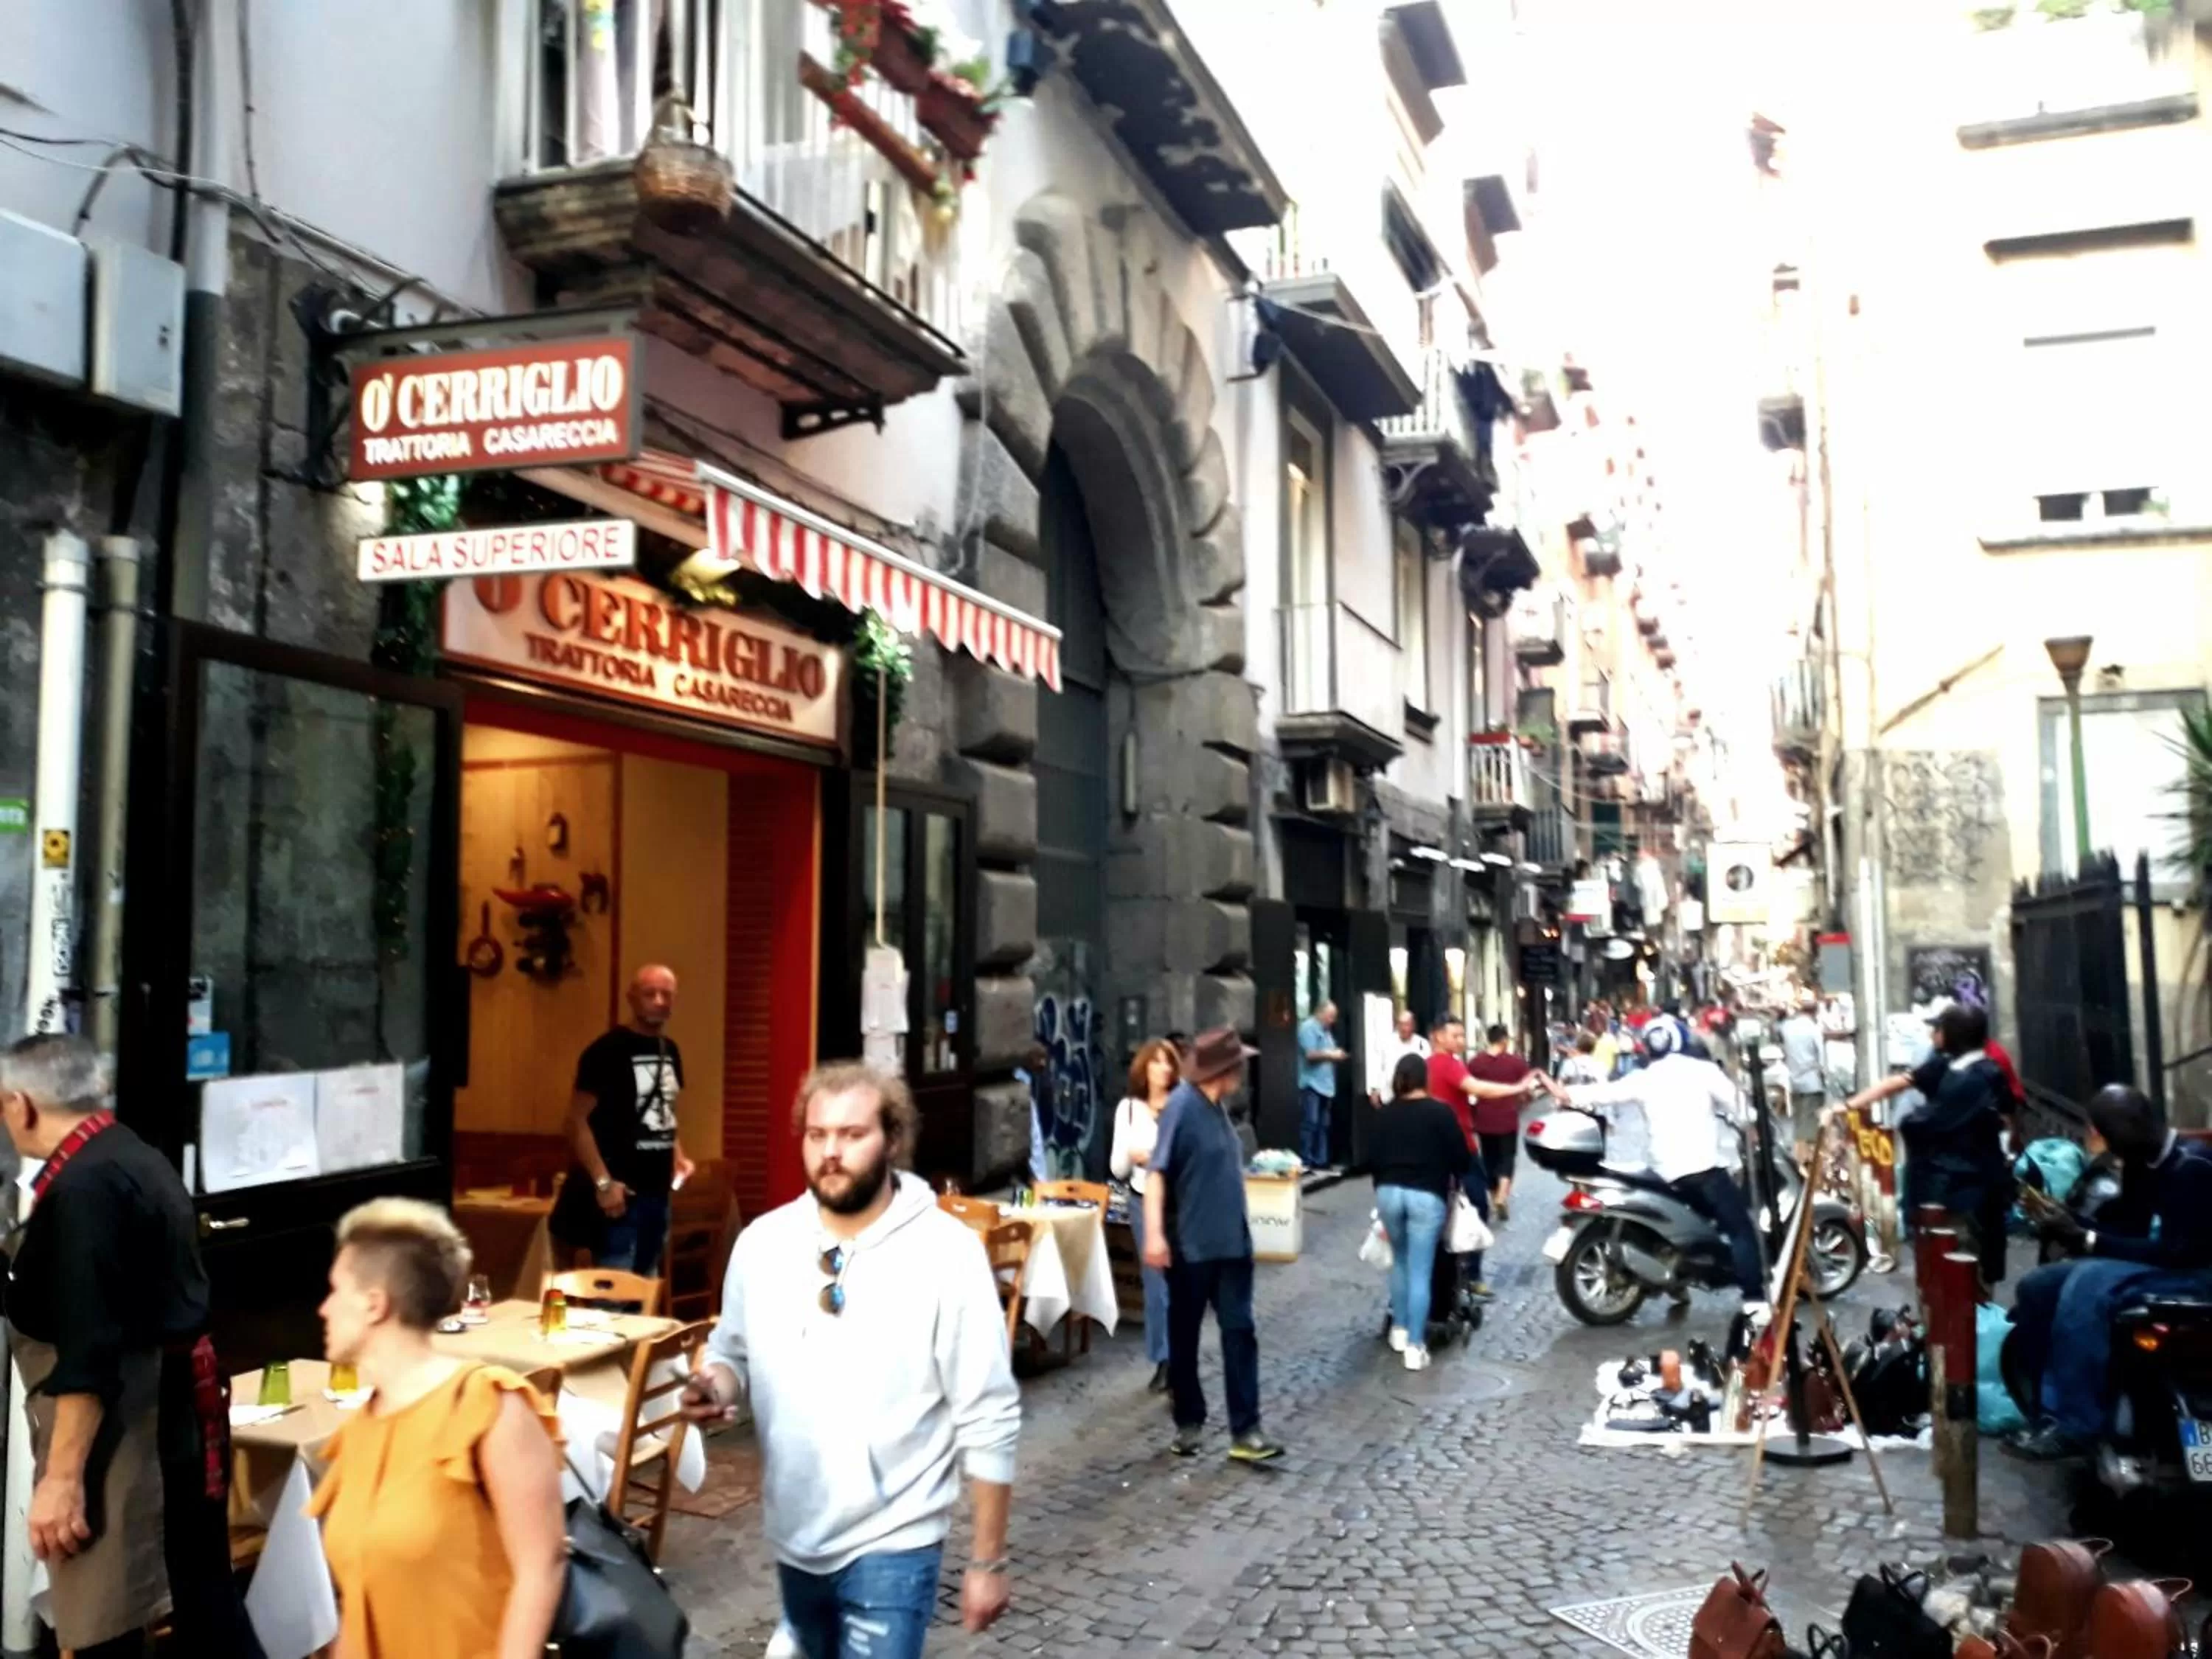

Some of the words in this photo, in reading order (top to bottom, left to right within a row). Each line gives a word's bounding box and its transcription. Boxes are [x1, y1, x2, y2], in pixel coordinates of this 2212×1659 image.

[361, 372, 394, 433] O'
[397, 354, 624, 428] CERRIGLIO
[363, 431, 471, 465] TRATTORIA
[483, 418, 619, 455] CASARECCIA
[372, 541, 442, 574] SALA
[452, 526, 621, 568] SUPERIORE
[538, 572, 827, 700] CERRIGLIO
[524, 632, 656, 690] TRATTORIA
[674, 669, 794, 723] CASARECCIA
